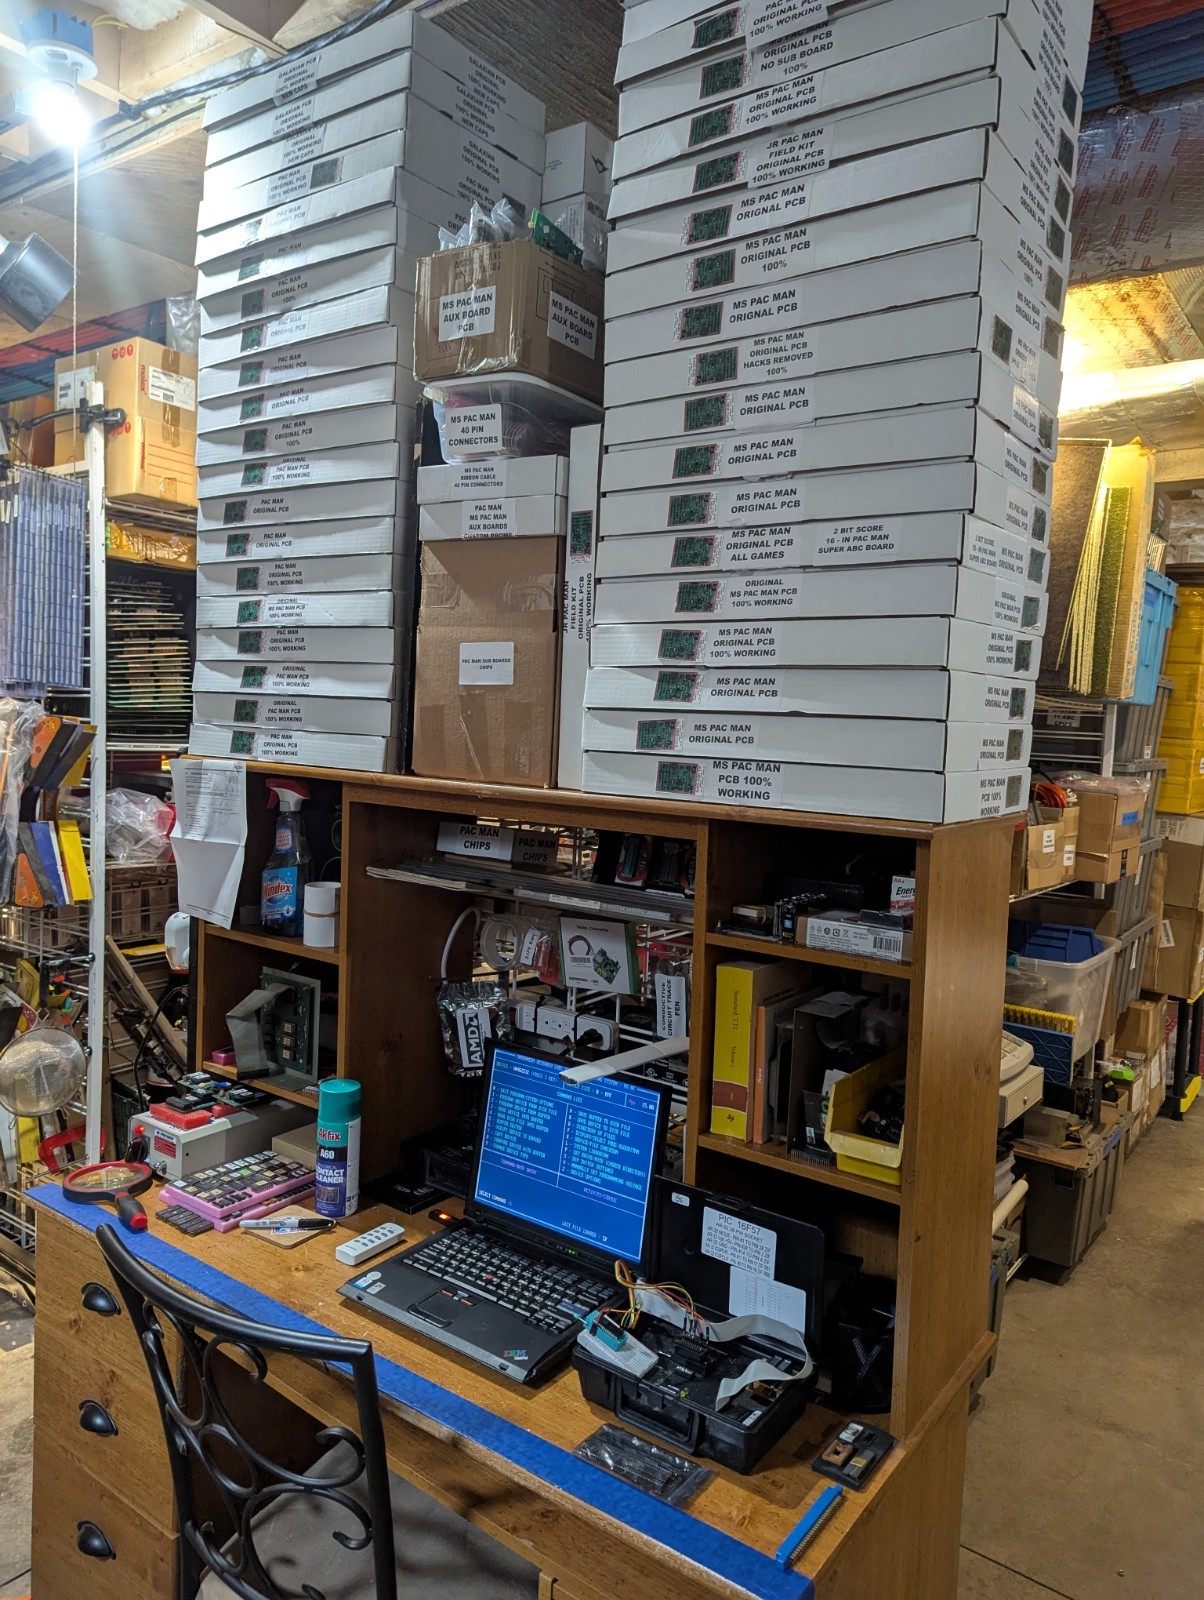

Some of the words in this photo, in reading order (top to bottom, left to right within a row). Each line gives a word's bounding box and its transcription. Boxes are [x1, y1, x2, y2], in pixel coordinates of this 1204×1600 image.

[750, 24, 773, 38] 100%
[776, 4, 822, 27] WORKING
[754, 4, 798, 25] ORIGINAL
[764, 39, 809, 58] ORIGINAL
[813, 30, 832, 42] PCB
[761, 61, 774, 71] NO
[777, 54, 796, 66] SUB
[800, 42, 833, 58] BOARD
[279, 63, 304, 78] GALAXIAN
[306, 57, 317, 66] PCB
[784, 62, 808, 76] 100%
[766, 141, 778, 149] JR
[781, 135, 799, 145] PAC
[802, 128, 823, 140] MAN
[769, 147, 795, 158] FIELD
[799, 141, 815, 150] KIT
[757, 155, 801, 171] ORIGINAL
[805, 149, 824, 159] PCB
[753, 172, 776, 183] 100%
[779, 159, 825, 176] WORKING
[741, 198, 755, 208] MS
[759, 192, 778, 203] PAC
[781, 184, 805, 197] MAN
[737, 204, 781, 220] ORIGNAL
[785, 197, 806, 208] PCB
[443, 299, 454, 310] MS
[456, 296, 471, 308] PAC
[474, 293, 492, 304] MAN
[444, 311, 460, 323] AUX
[462, 307, 490, 319] BOARD
[552, 299, 562, 310] MS
[565, 304, 578, 318] PAC
[580, 312, 595, 328] MAN
[458, 323, 474, 332] PCB
[552, 313, 567, 327] AUX
[569, 322, 592, 340] BOARD
[565, 333, 579, 346] PCB
[786, 332, 804, 340] MAN
[750, 345, 788, 357] ORIGINAL
[791, 342, 807, 350] PCB
[744, 359, 770, 369] HACKS
[773, 352, 813, 364] REMOVED
[767, 366, 787, 376] 100%
[449, 436, 498, 446] CONNECTORS
[769, 527, 791, 535] MAN
[726, 540, 770, 550] ORIGINAL
[751, 551, 784, 560] GAMES
[713, 761, 728, 769] MS
[732, 762, 752, 770] PAC
[756, 763, 780, 772] MAN
[719, 775, 739, 783] PCB
[744, 776, 772, 786] 100%
[980, 779, 987, 788] MS
[996, 778, 1005, 786] MAN
[718, 788, 770, 800] WORKING
[982, 793, 990, 802] PCB
[991, 792, 1001, 800] 100%
[980, 806, 999, 816] WORKING
[460, 826, 476, 835] PAC
[479, 827, 499, 837] MAN
[464, 840, 490, 850] CHIPS
[519, 838, 535, 847] PAC
[537, 839, 556, 848] MAN
[523, 852, 548, 862] CHIPS
[468, 1027, 482, 1063] AMD
[319, 1128, 341, 1141] Akfix
[320, 1149, 334, 1159] A60
[719, 1214, 732, 1225] PIC
[738, 1221, 760, 1235] 16F57
